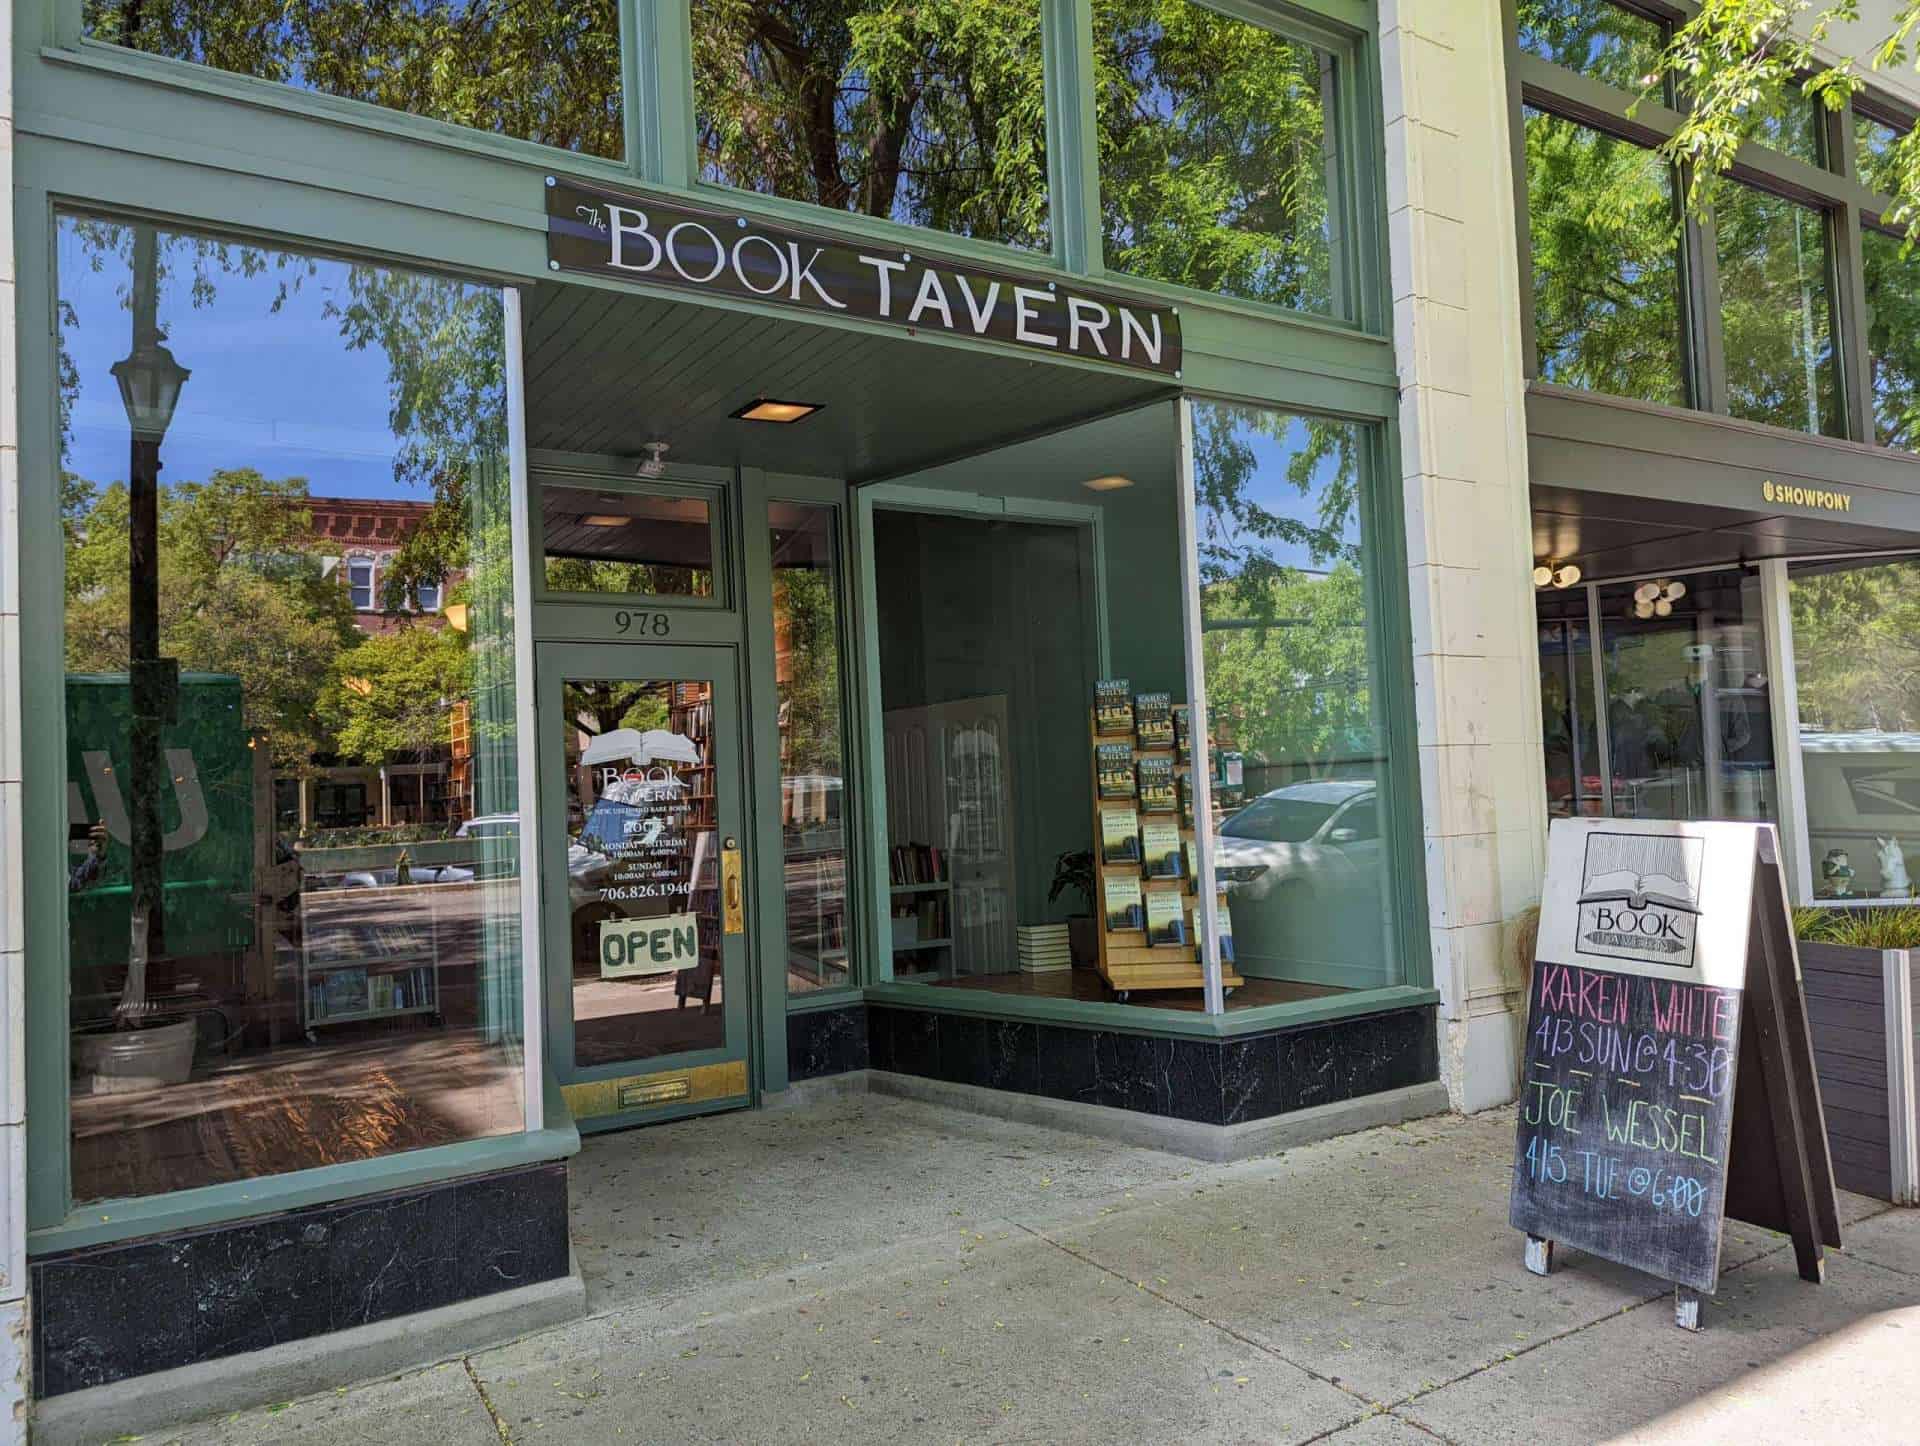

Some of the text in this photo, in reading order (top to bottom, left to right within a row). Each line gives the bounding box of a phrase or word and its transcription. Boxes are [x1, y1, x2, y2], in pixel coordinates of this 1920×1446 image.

[576, 203, 1163, 365] The BOOK TAVERN
[1775, 484, 1850, 511] SHOWPONY
[615, 610, 670, 636] 978
[602, 766, 691, 788] BOOK
[614, 790, 677, 802] AVERN
[600, 841, 638, 851] MONDAY
[628, 862, 662, 871] SUNDAY
[600, 881, 690, 902] 706.826.1940
[1597, 908, 1687, 940] BOOK
[602, 925, 697, 968] OPEN
[1541, 966, 1737, 1040] KAREN WHITE
[1525, 1080, 1718, 1164] JOE WESSEL
[1576, 1150, 1622, 1200] TUE
